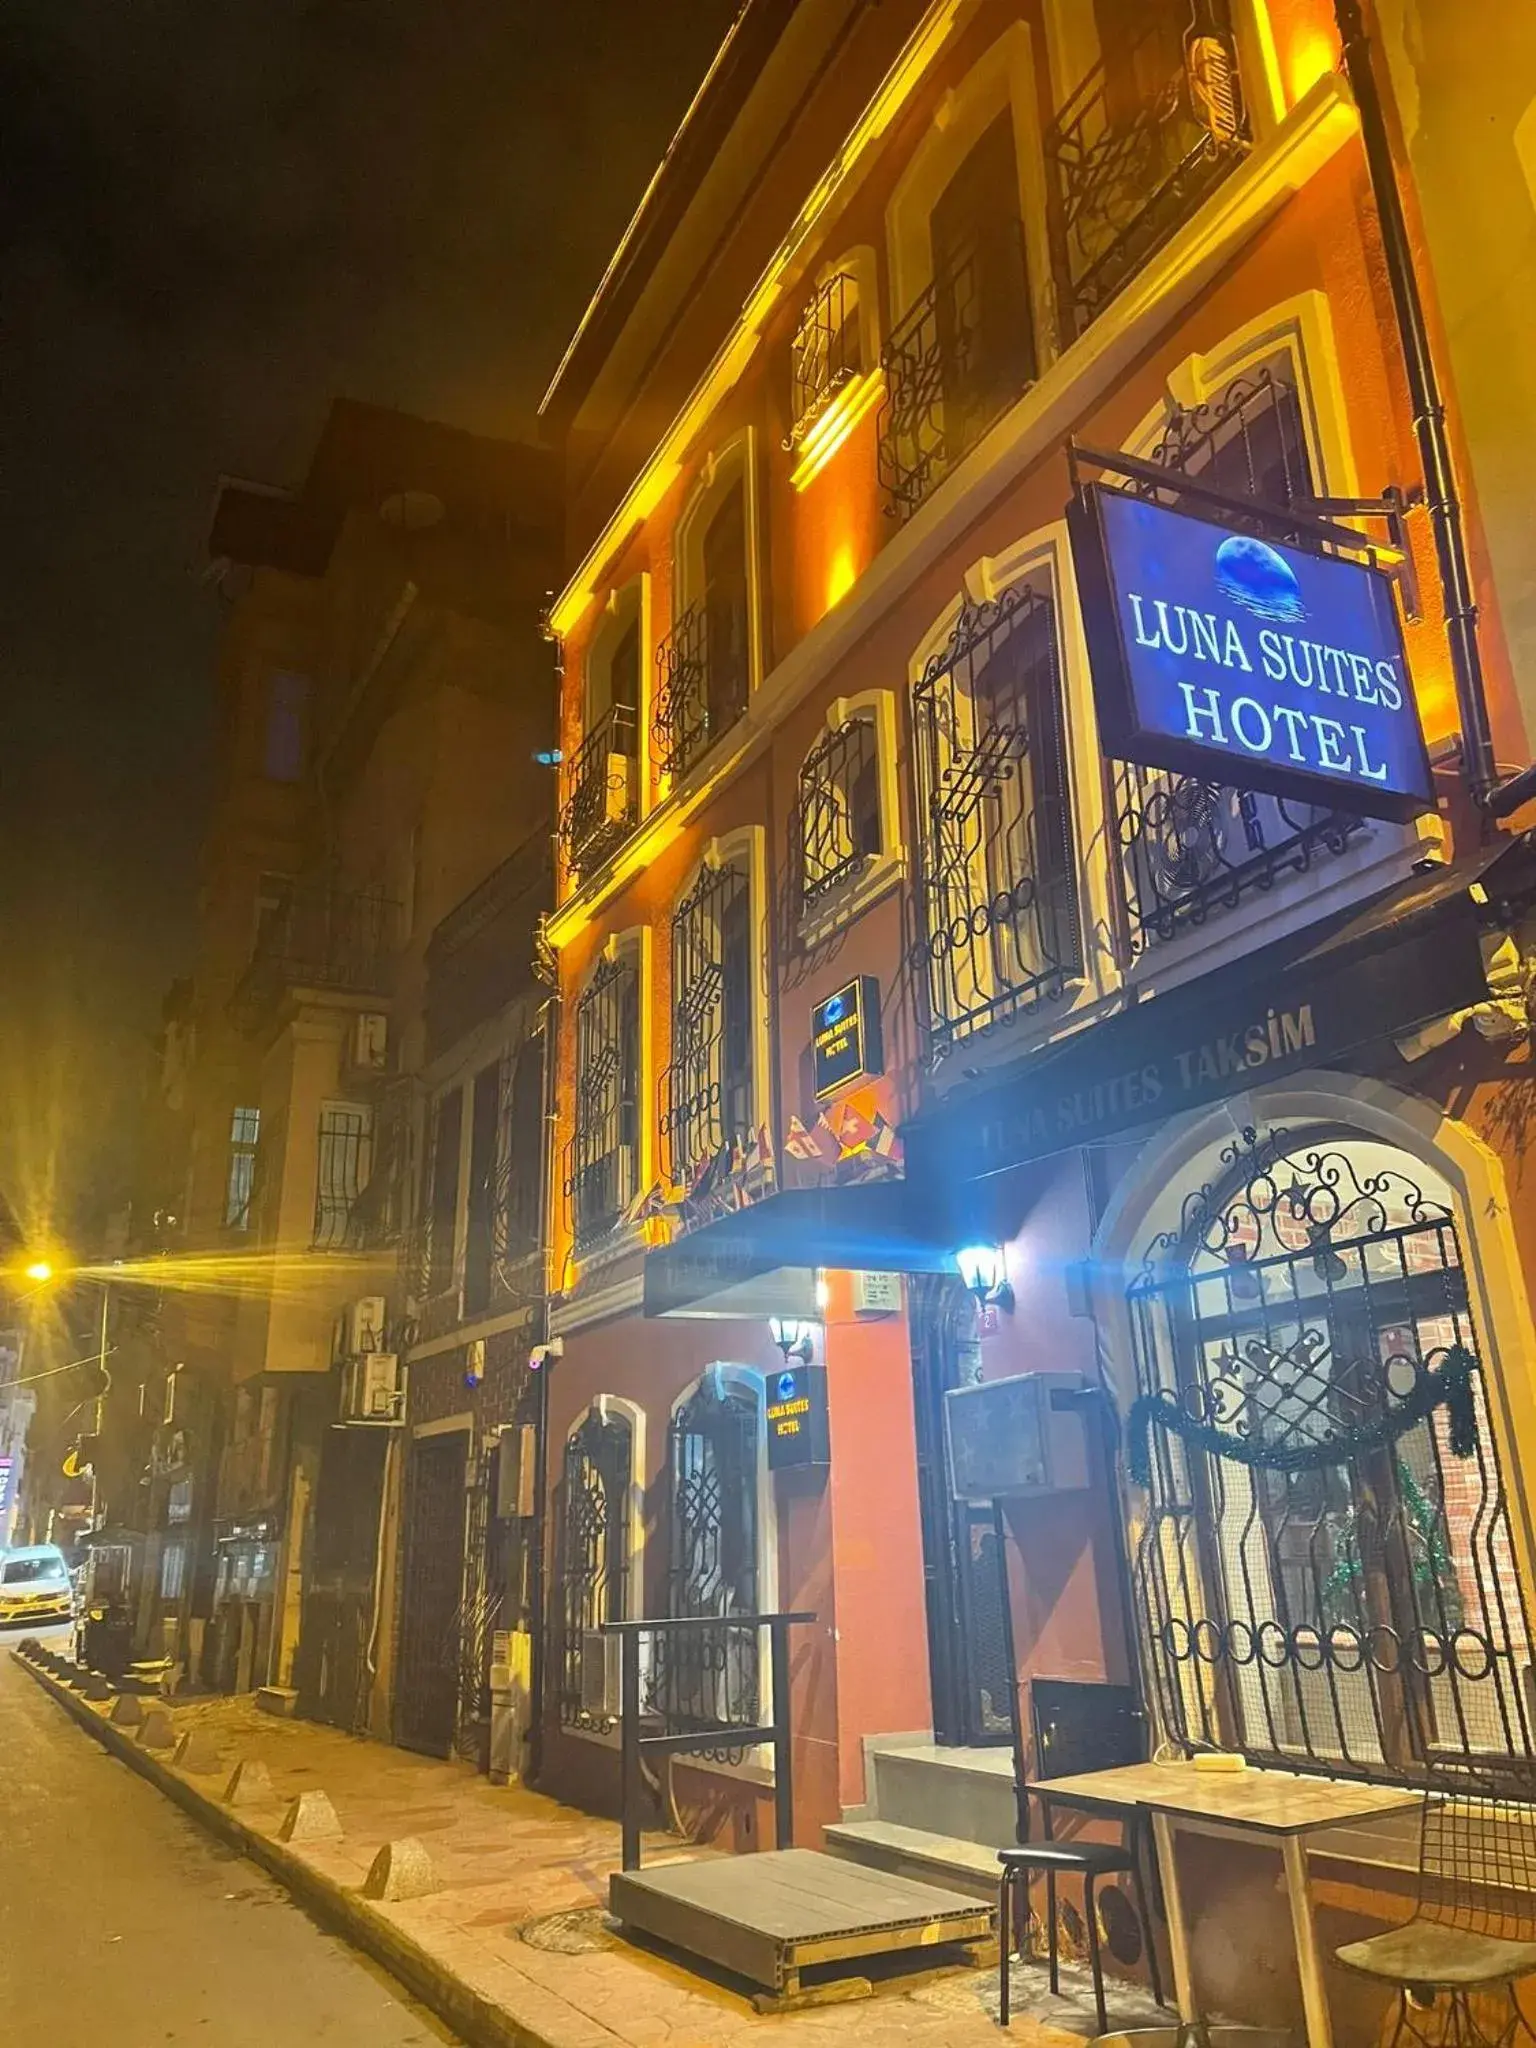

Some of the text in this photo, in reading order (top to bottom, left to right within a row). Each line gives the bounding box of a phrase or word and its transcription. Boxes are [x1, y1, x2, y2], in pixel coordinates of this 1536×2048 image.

[1128, 593, 1403, 711] LUNA SUITES
[1178, 682, 1387, 781] HOTEL
[1056, 1064, 1165, 1134] SUITES
[1175, 1003, 1317, 1090] TAKSİM
